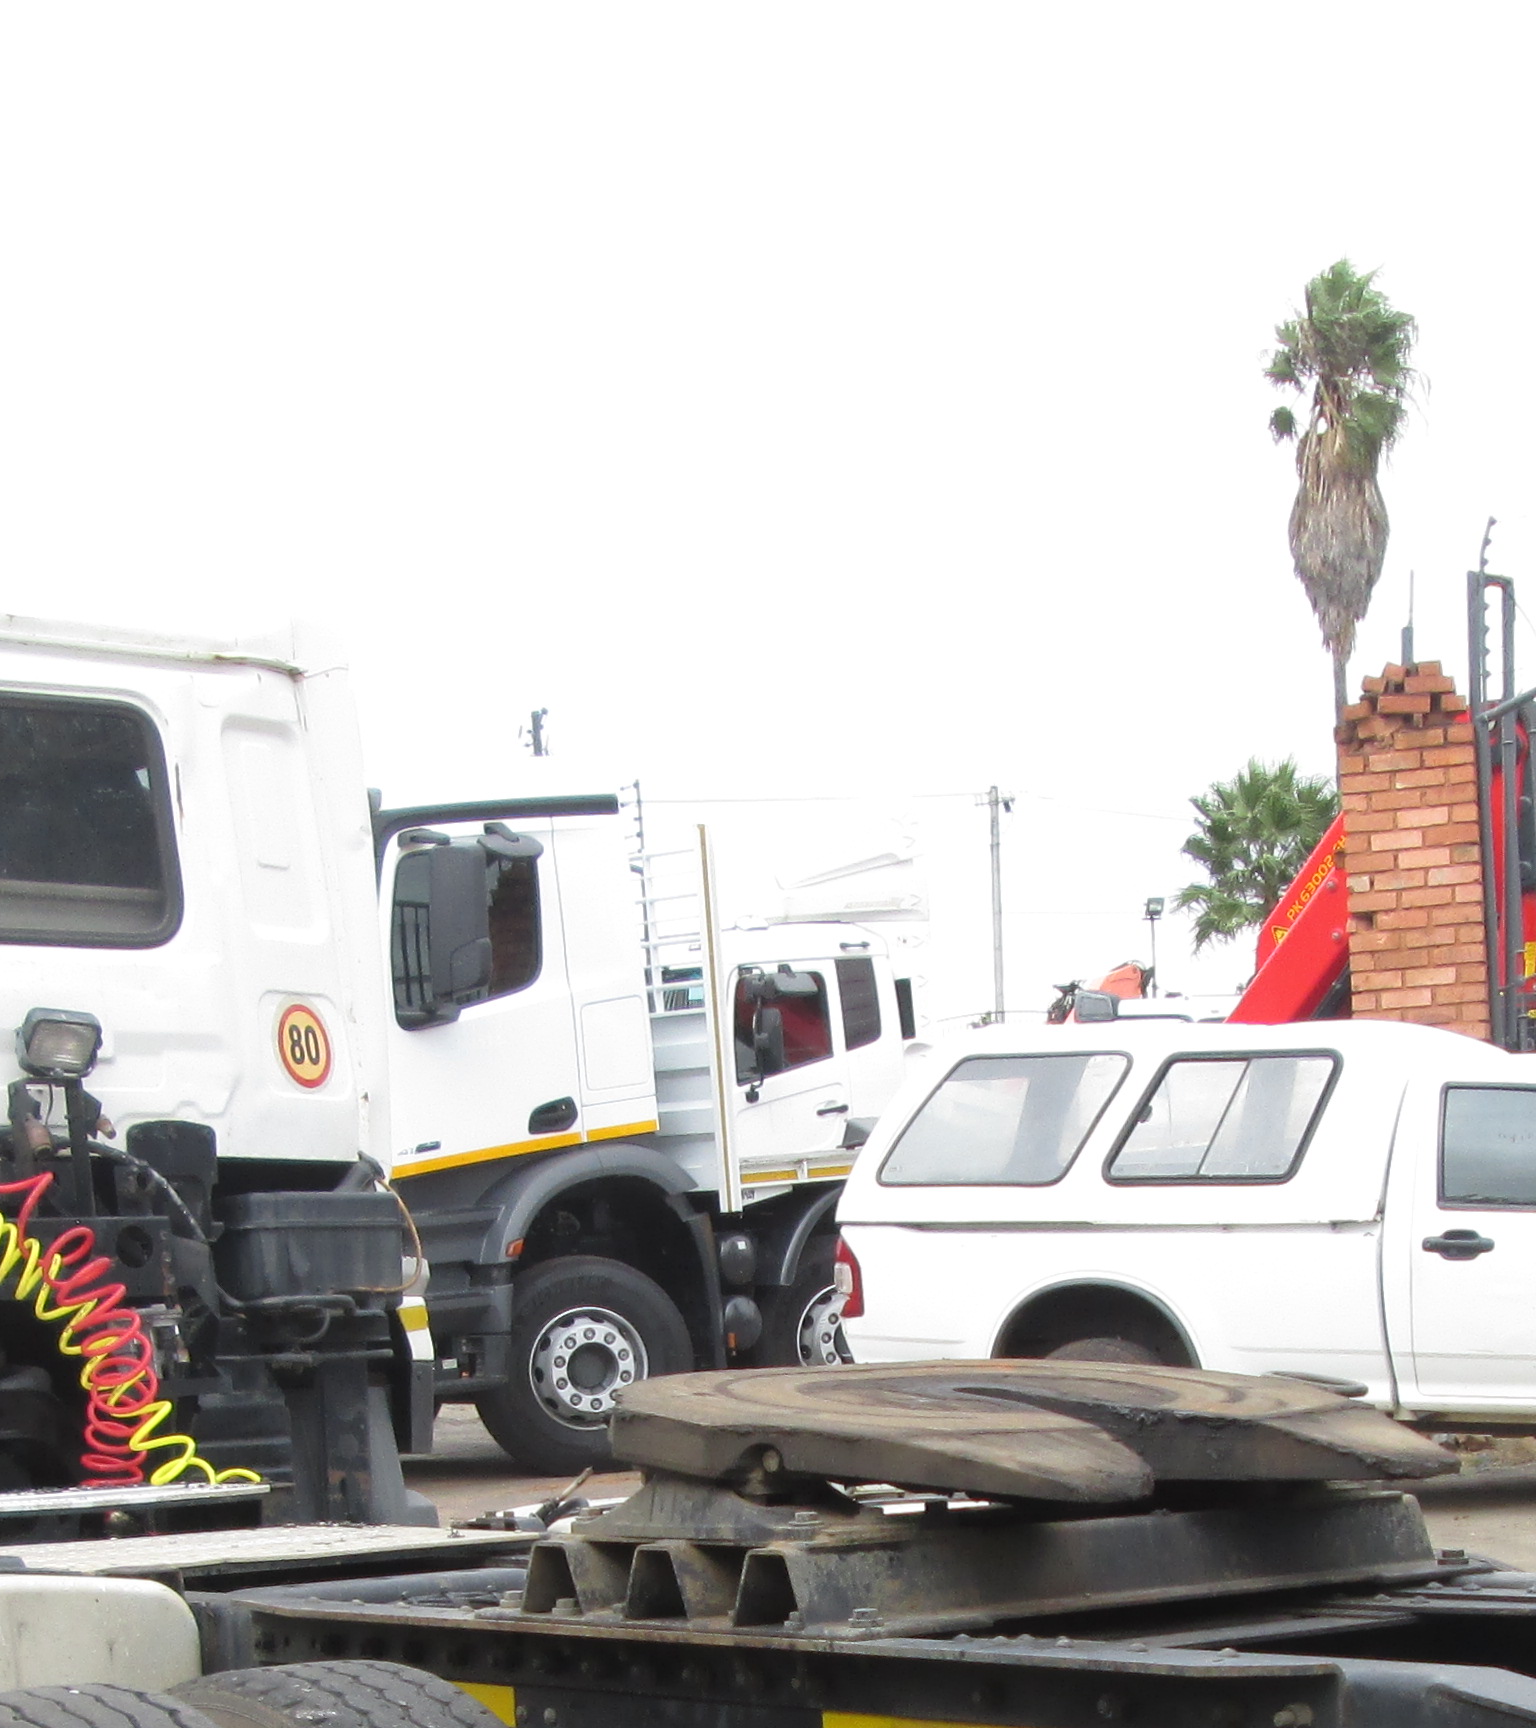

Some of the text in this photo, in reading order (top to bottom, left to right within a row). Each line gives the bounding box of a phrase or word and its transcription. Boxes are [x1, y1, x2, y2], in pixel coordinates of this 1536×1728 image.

[1286, 900, 1304, 921] PK
[1300, 854, 1334, 903] 63002
[289, 1023, 320, 1066] 80
